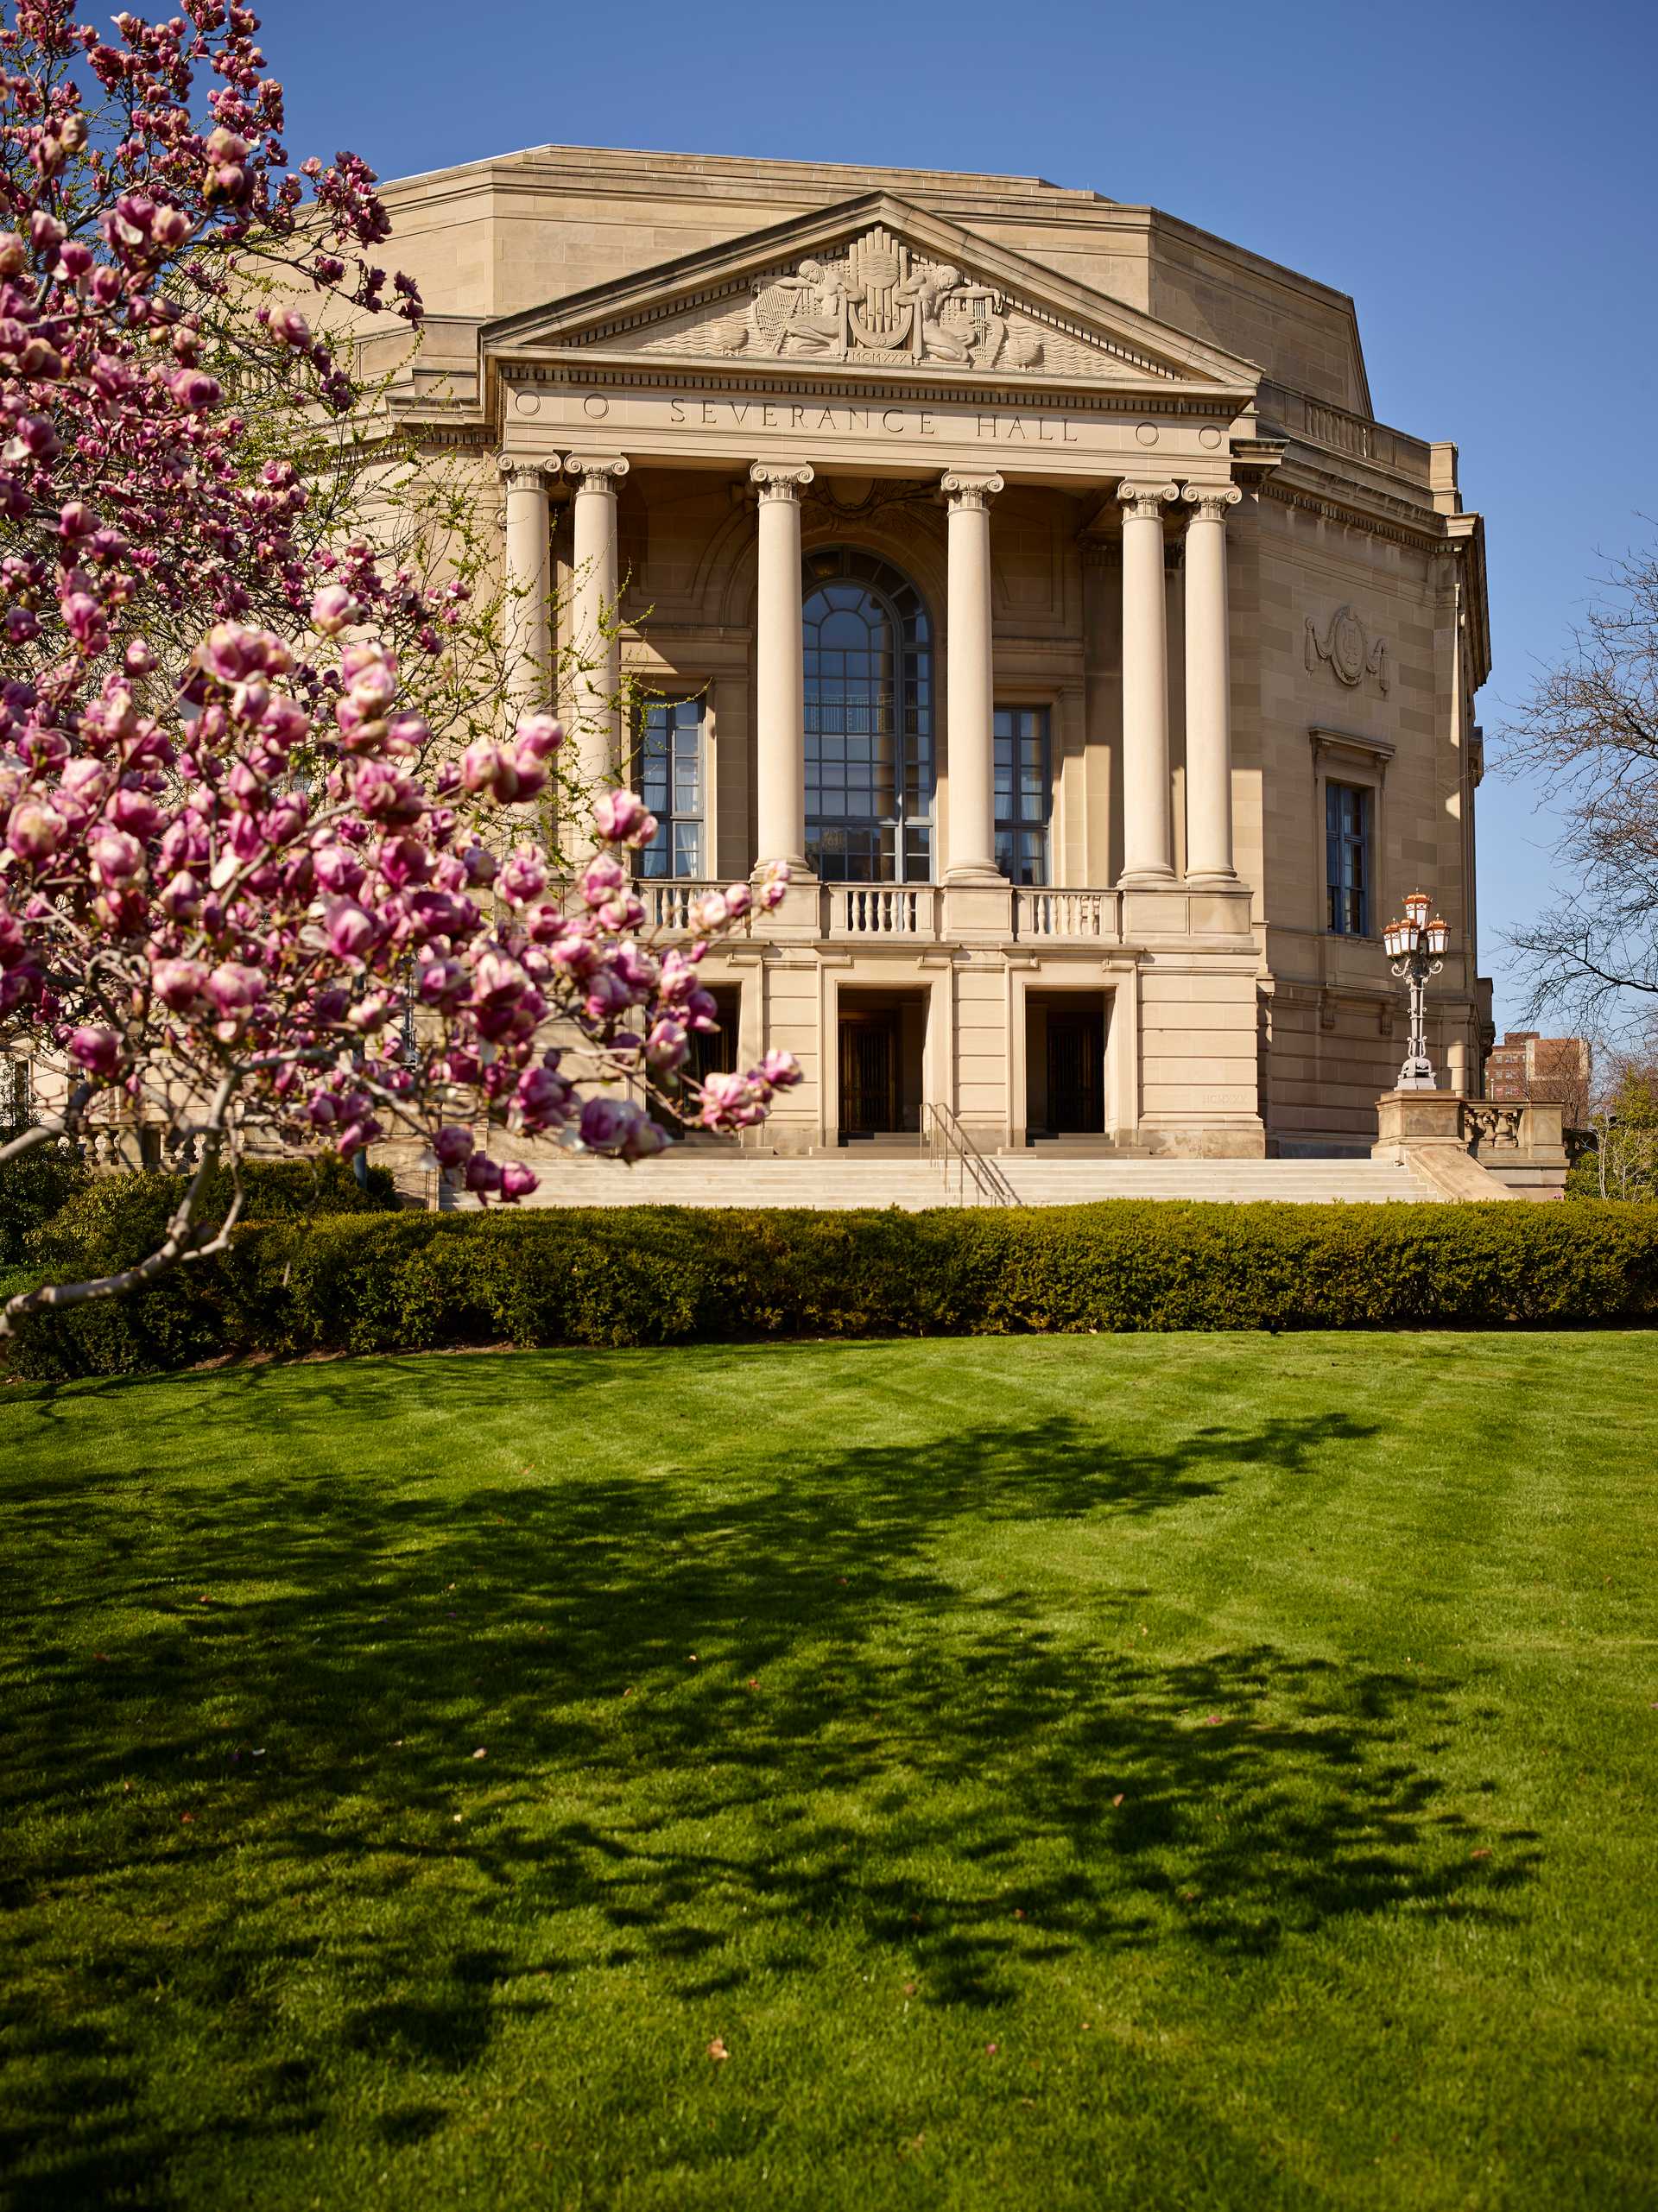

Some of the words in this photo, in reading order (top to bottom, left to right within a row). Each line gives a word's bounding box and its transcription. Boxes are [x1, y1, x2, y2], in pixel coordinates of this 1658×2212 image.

[851, 351, 908, 363] MCMXXX
[670, 397, 935, 435] SEVERANCE
[976, 414, 1079, 442] HALL
